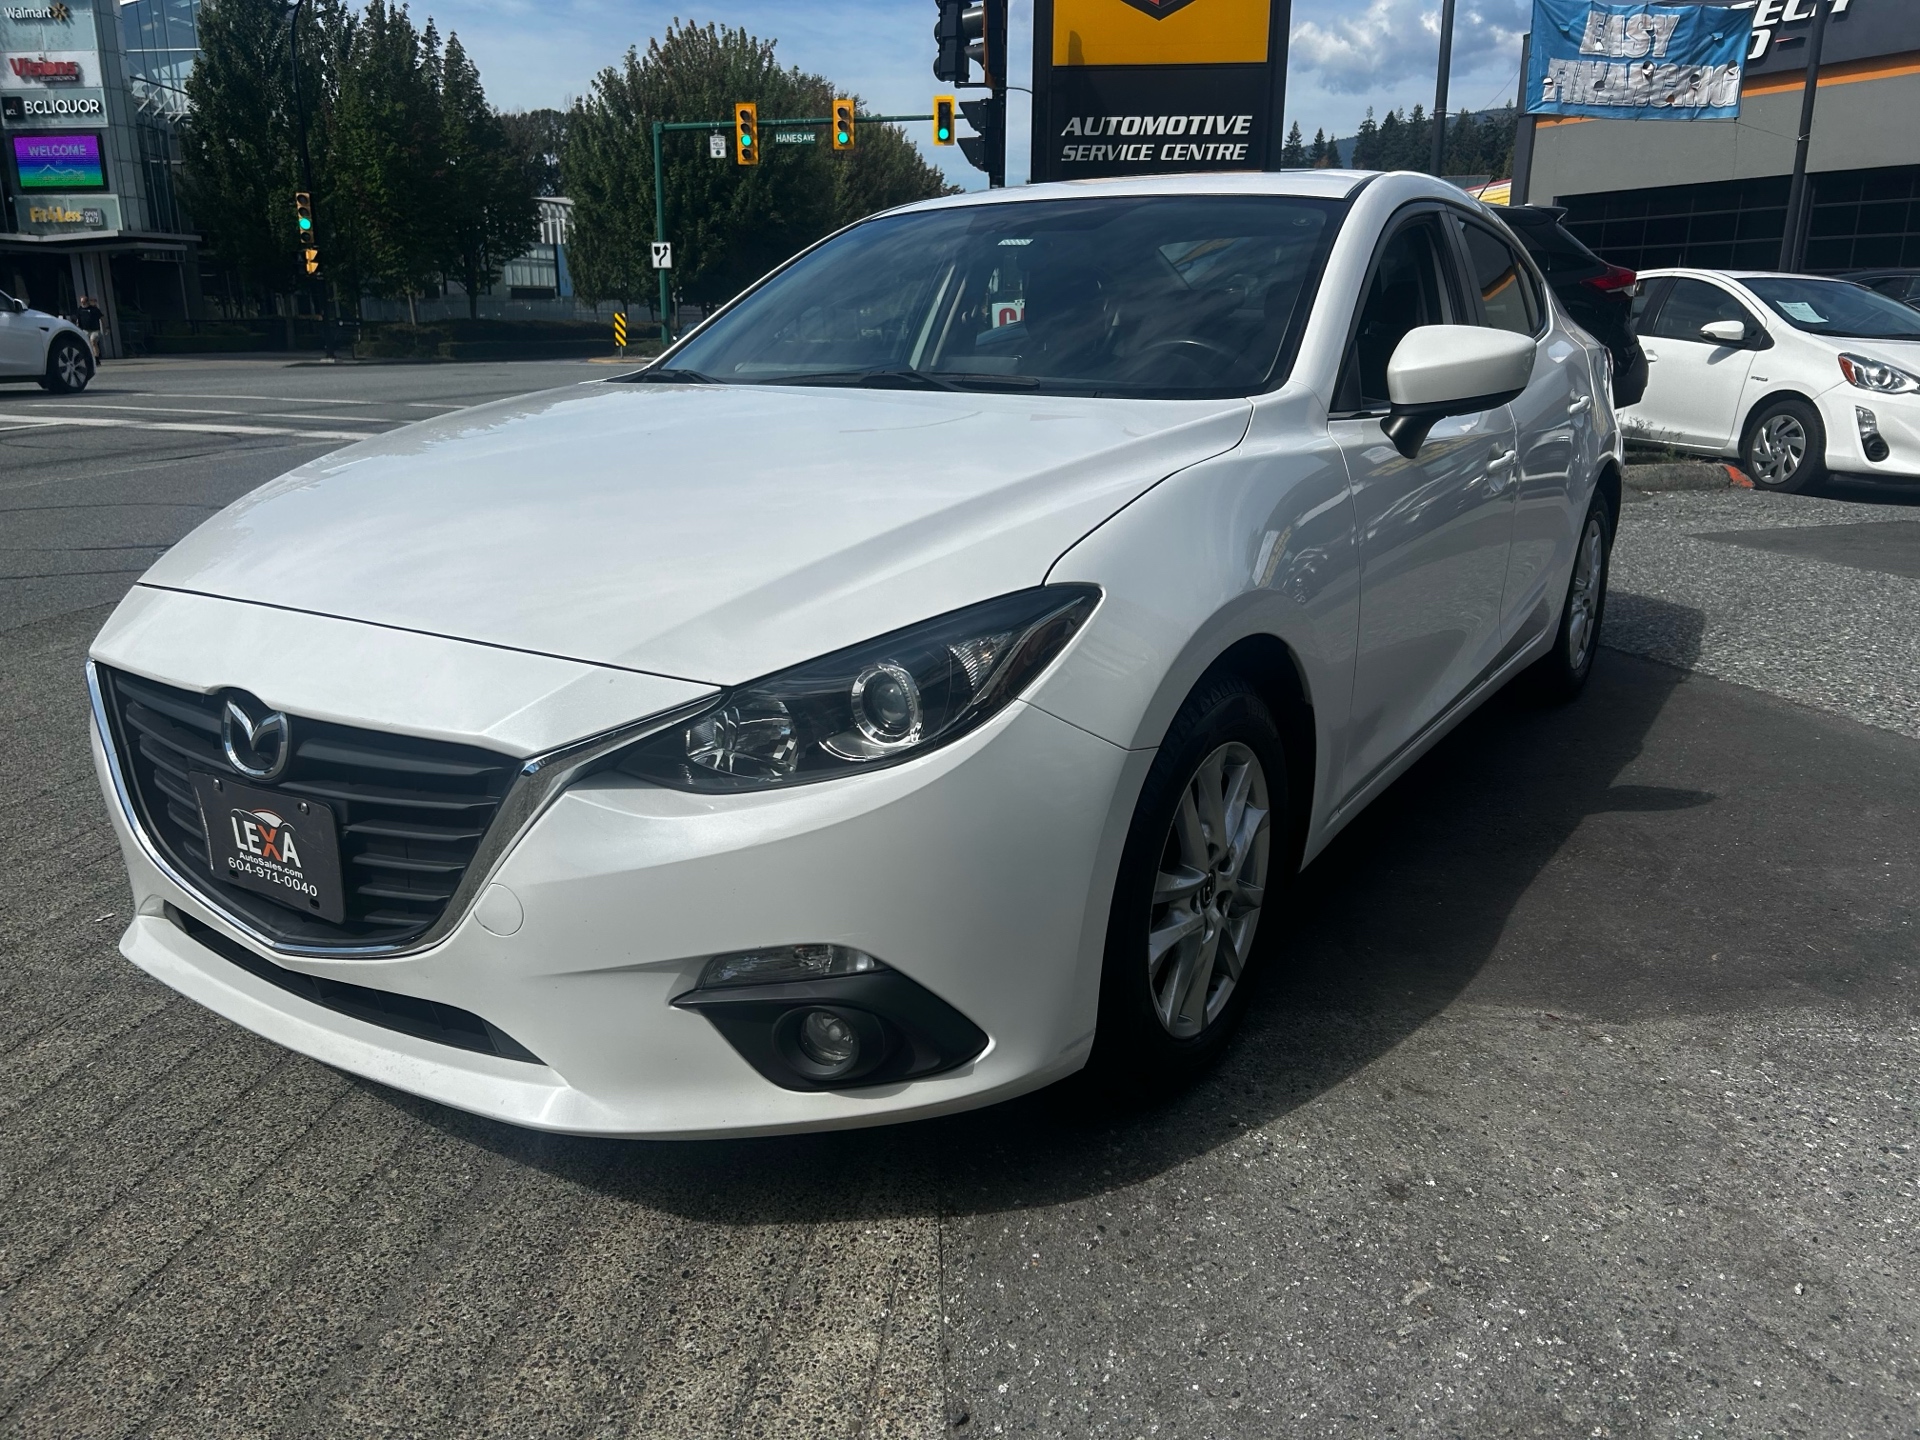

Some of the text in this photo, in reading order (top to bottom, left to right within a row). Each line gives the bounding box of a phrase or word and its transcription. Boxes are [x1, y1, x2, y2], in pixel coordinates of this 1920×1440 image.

[4, 6, 51, 19] Walmart
[1579, 10, 1680, 58] EASY
[9, 57, 77, 77] Visions
[1542, 58, 1741, 108] FINANCING
[1060, 115, 1252, 137] AUTOMOTIVE
[776, 133, 816, 143] HANES AVE
[28, 145, 87, 156] WELCOME
[1061, 143, 1249, 162] SERVICE CENTRE
[231, 816, 302, 869] LEXA
[228, 856, 318, 897] 604-971-0040
[239, 851, 304, 880] AutoSales.com
